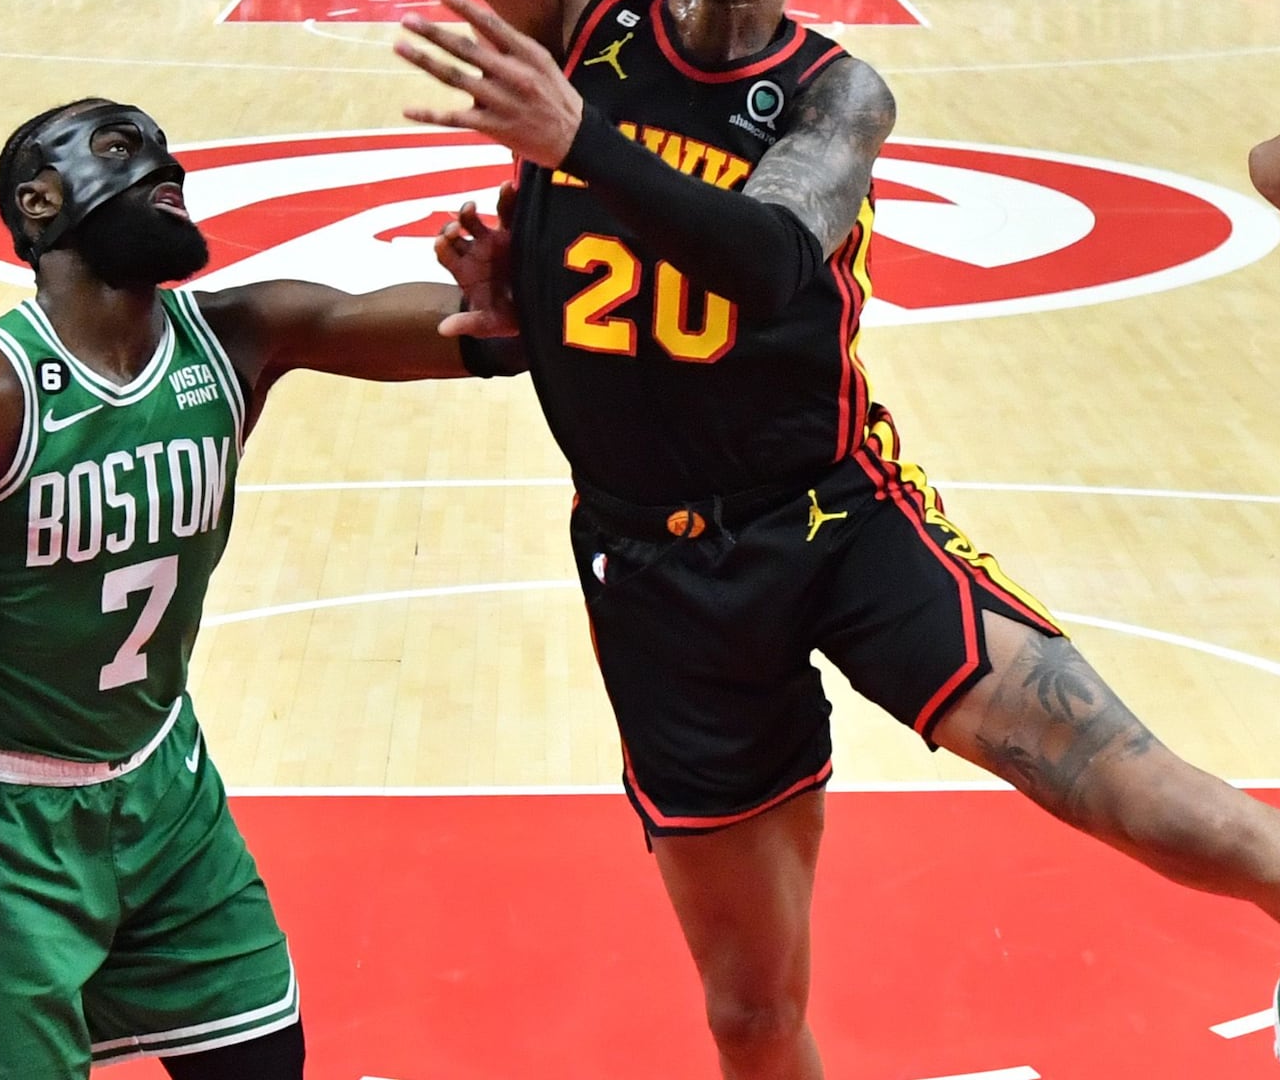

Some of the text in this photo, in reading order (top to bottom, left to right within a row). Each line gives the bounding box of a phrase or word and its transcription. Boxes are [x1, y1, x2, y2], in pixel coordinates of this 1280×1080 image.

[615, 8, 642, 29] 6
[563, 232, 738, 364] 20
[41, 361, 63, 392] 6
[168, 364, 215, 392] VISTA
[176, 383, 220, 412] PRINT
[26, 435, 231, 570] BOSTON
[98, 556, 179, 693] 7
